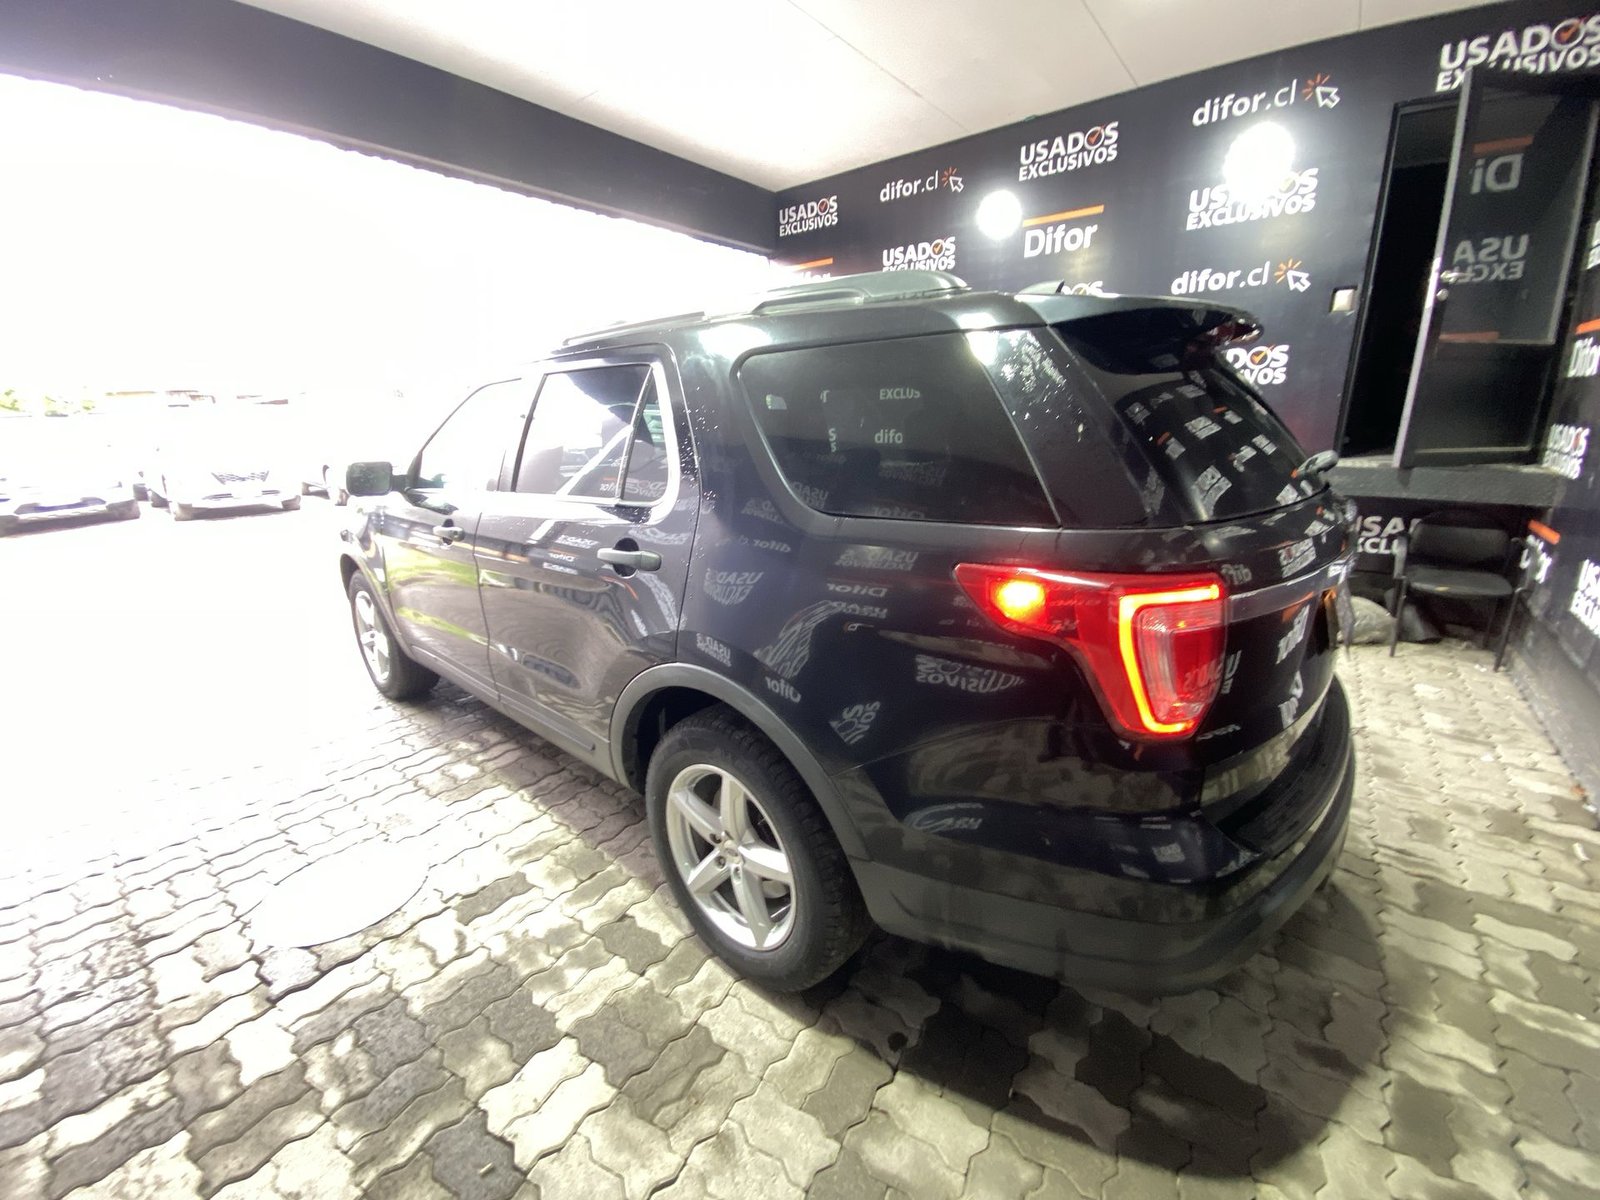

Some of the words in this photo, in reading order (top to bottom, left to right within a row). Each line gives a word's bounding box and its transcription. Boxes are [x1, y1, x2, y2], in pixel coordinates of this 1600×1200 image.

[1439, 12, 1600, 70] USADOS
[1192, 78, 1298, 127] difor.cl
[1020, 121, 1119, 165] USADOS
[1018, 143, 1118, 182] EXCLUSIVOS
[879, 169, 939, 203] difor.cl
[1188, 167, 1319, 213] USOS
[779, 195, 838, 225] USADOS
[779, 211, 839, 238] EXCLUSIVOS
[882, 236, 956, 267] USADOS
[1023, 223, 1099, 258] Difor
[1170, 261, 1271, 296] difor.cl
